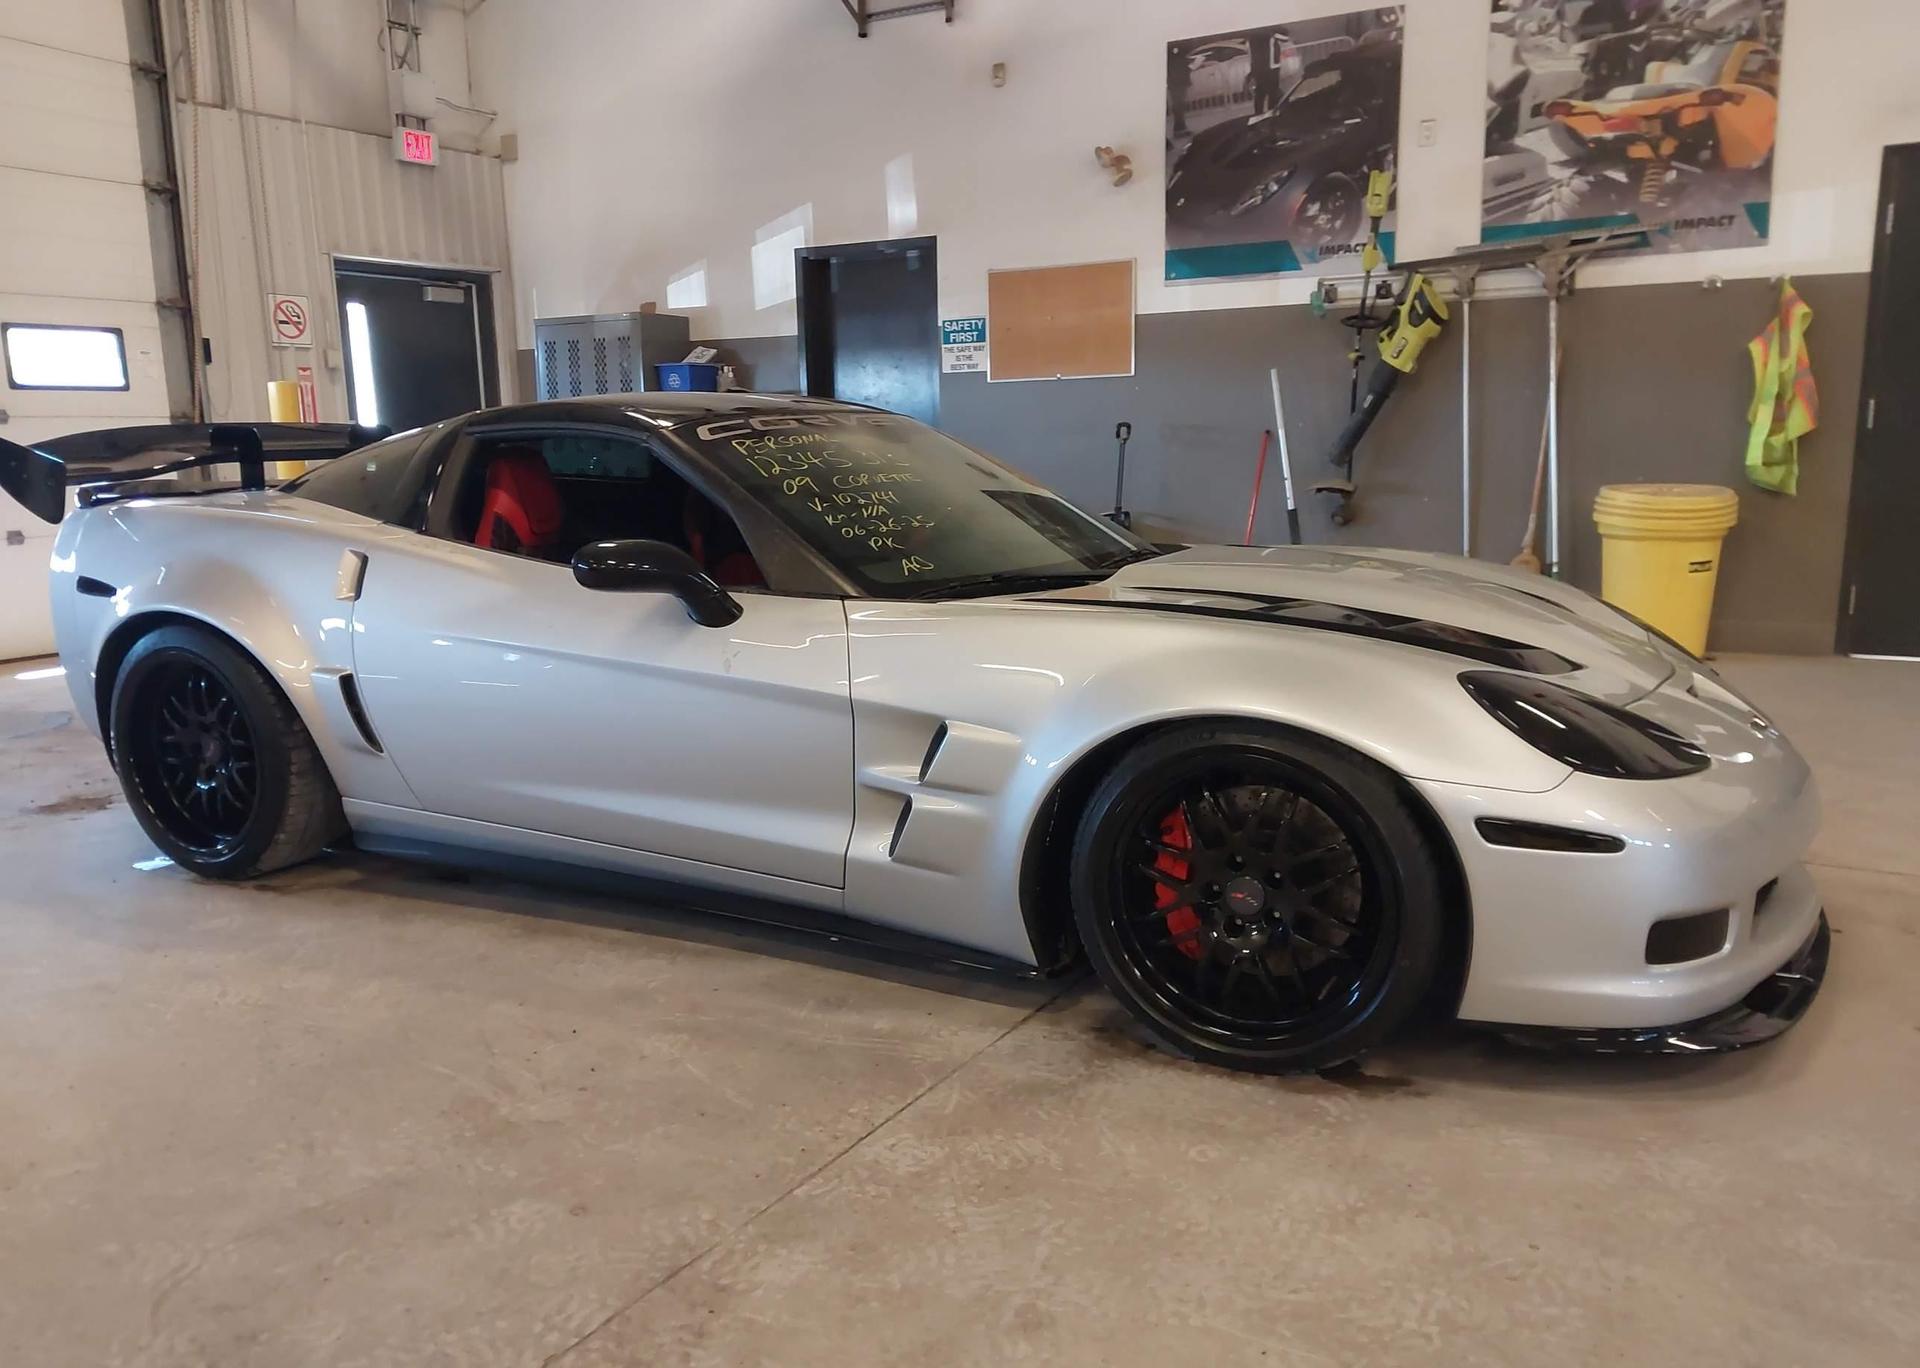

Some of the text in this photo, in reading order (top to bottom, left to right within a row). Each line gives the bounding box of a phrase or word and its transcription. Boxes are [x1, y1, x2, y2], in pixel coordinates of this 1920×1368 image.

[1674, 215, 1736, 230] IMPACT
[1319, 242, 1368, 256] IMPACT
[944, 319, 984, 331] SAFETY
[950, 332, 978, 343] FIRST
[731, 433, 840, 455] PERSONAL
[783, 476, 819, 495] 09
[868, 536, 905, 551] PK
